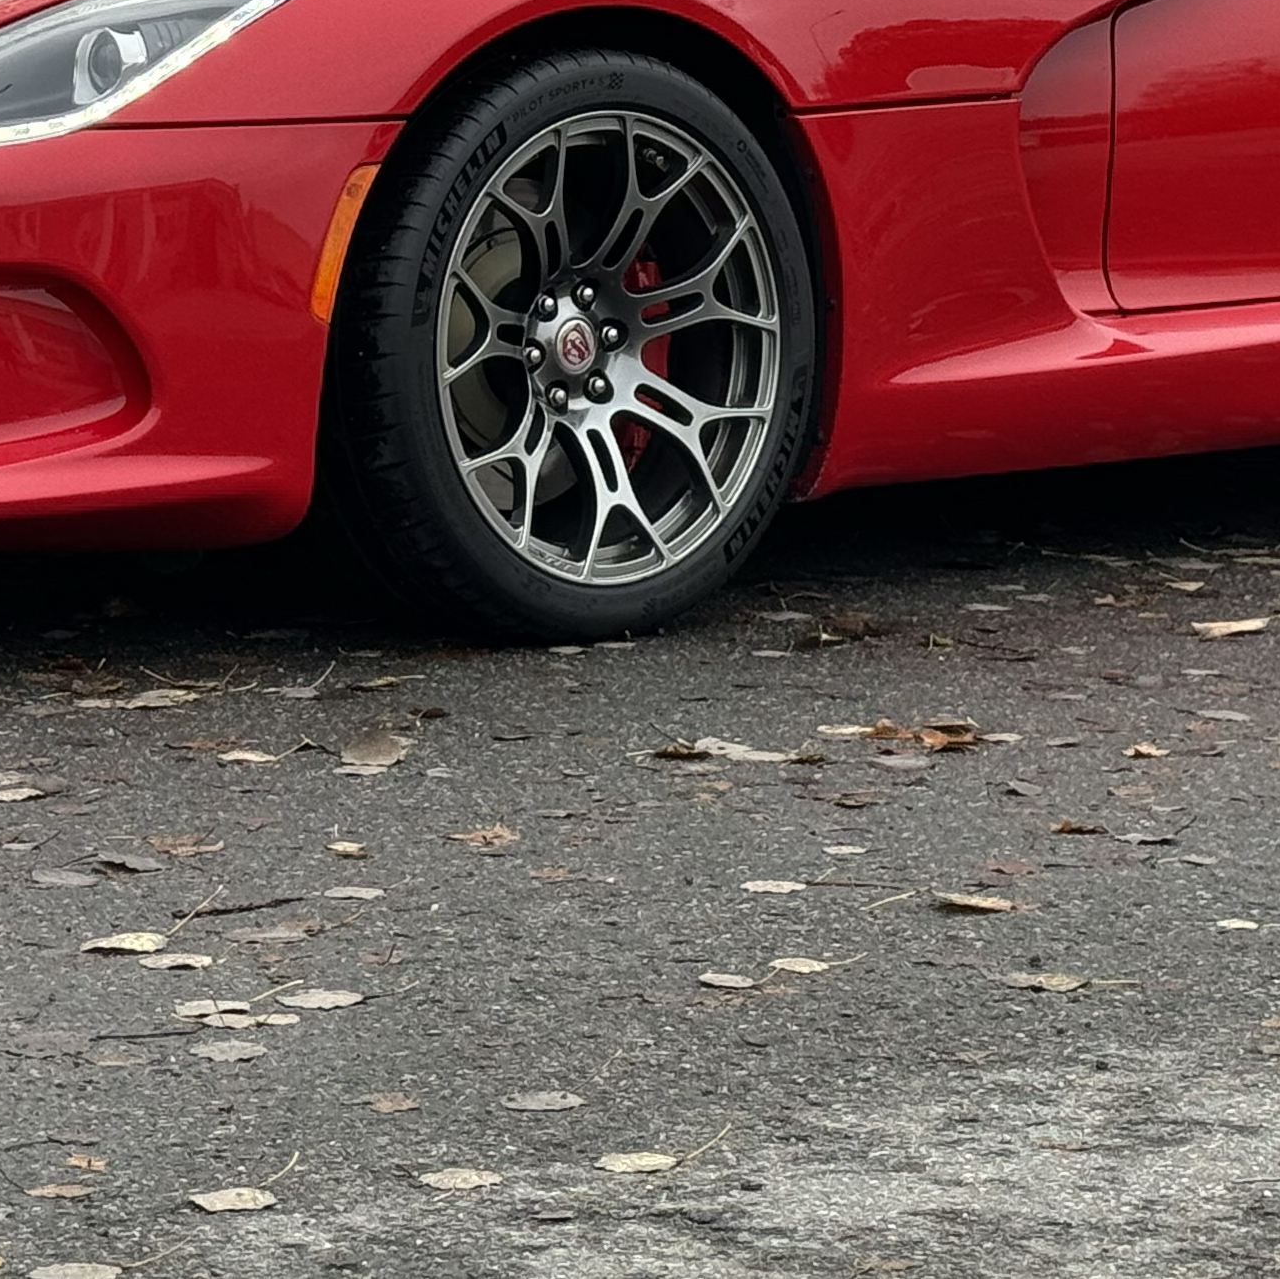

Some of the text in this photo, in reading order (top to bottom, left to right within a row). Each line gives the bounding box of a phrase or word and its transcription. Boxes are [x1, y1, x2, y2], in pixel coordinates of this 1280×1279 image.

[511, 95, 543, 122] PILOT
[548, 79, 588, 101] SPORT
[421, 123, 506, 282] MICHELIN
[725, 404, 801, 562] MICHELIN
